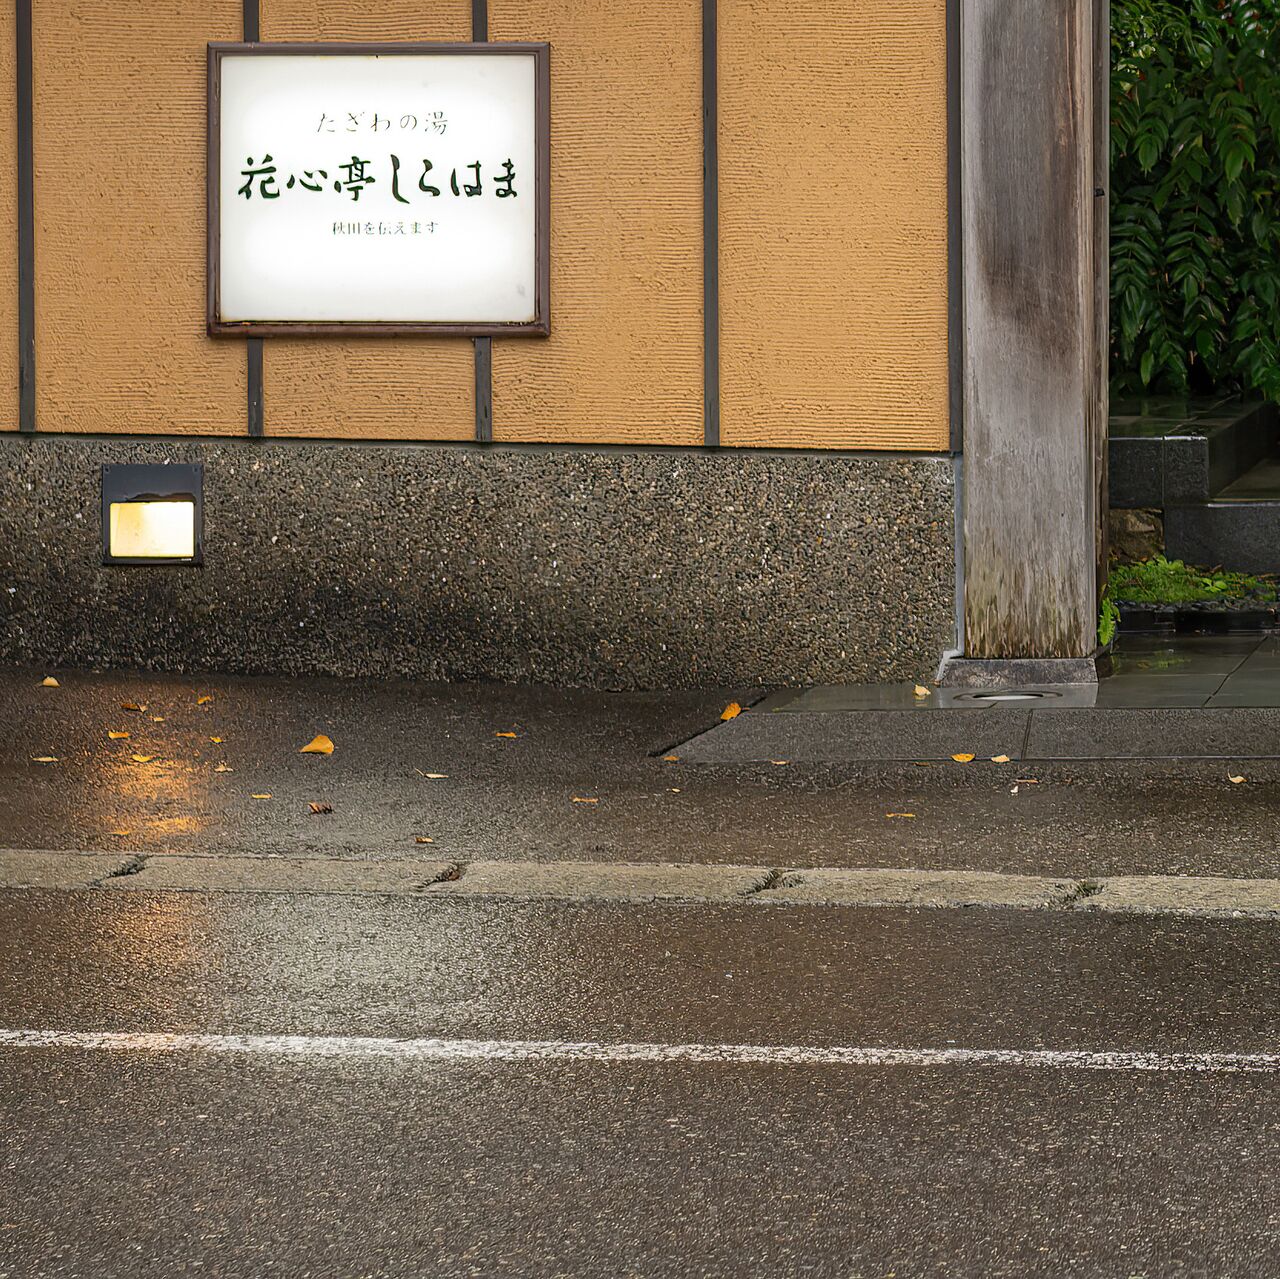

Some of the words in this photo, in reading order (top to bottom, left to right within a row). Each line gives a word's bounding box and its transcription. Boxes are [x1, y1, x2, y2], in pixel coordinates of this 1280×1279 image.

[316, 111, 448, 135] たざわの湯
[238, 153, 518, 204] 花心亭しらはま
[332, 221, 439, 235] 秋田を伝えます
